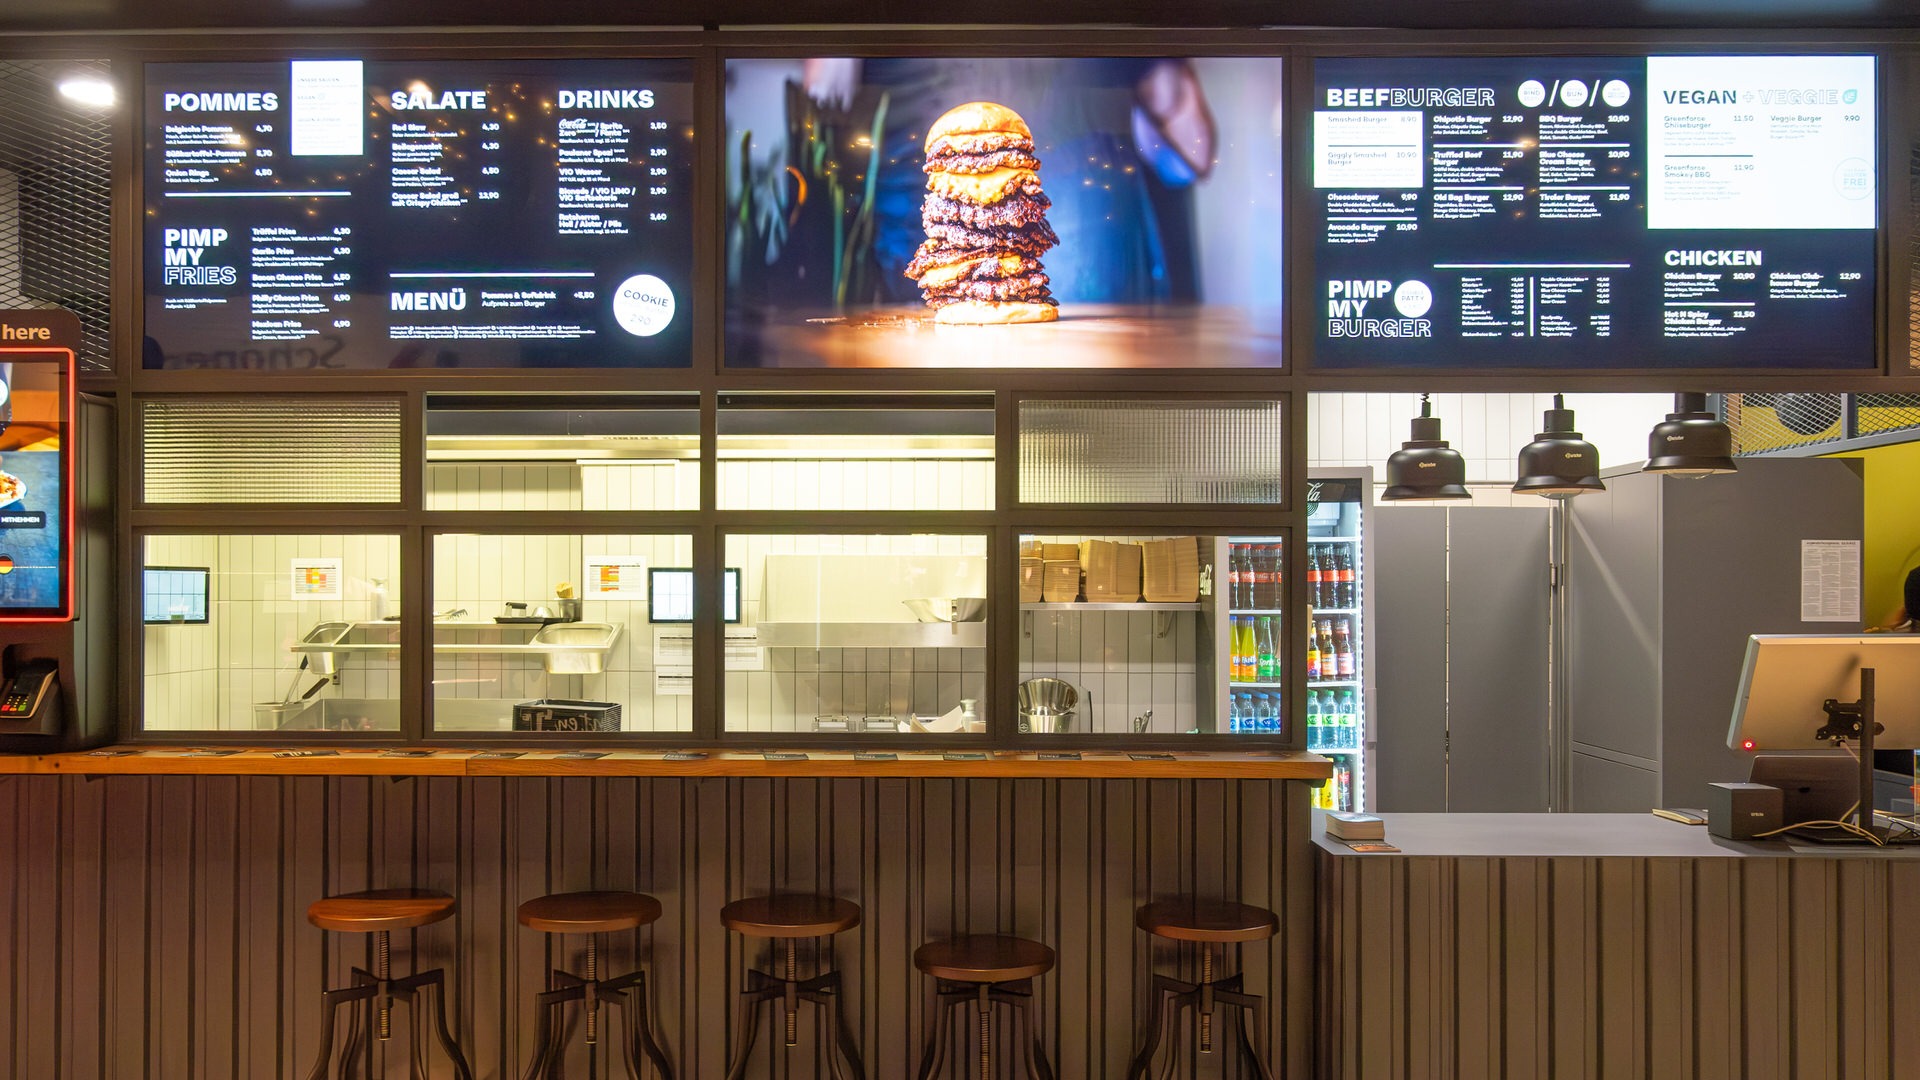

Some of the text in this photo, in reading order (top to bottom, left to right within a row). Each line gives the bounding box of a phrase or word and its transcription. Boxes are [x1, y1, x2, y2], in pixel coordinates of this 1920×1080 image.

[166, 93, 278, 111] POMMES
[392, 91, 486, 110] SALATE
[559, 90, 654, 108] DRINKS
[1663, 90, 1737, 104] VEGAN
[1758, 89, 1839, 105] VEGGIE
[1797, 115, 1822, 123] Burger
[165, 229, 227, 246] PIMP
[165, 248, 204, 265] MY
[1665, 250, 1761, 266] CHICKEN
[165, 266, 236, 285] FRIES
[1329, 280, 1392, 298] PIMP
[392, 288, 466, 310] MENÜ
[624, 290, 669, 307] COOKIE
[1329, 300, 1368, 317] MY
[2, 323, 51, 340] here
[1329, 319, 1431, 337] BURGER
